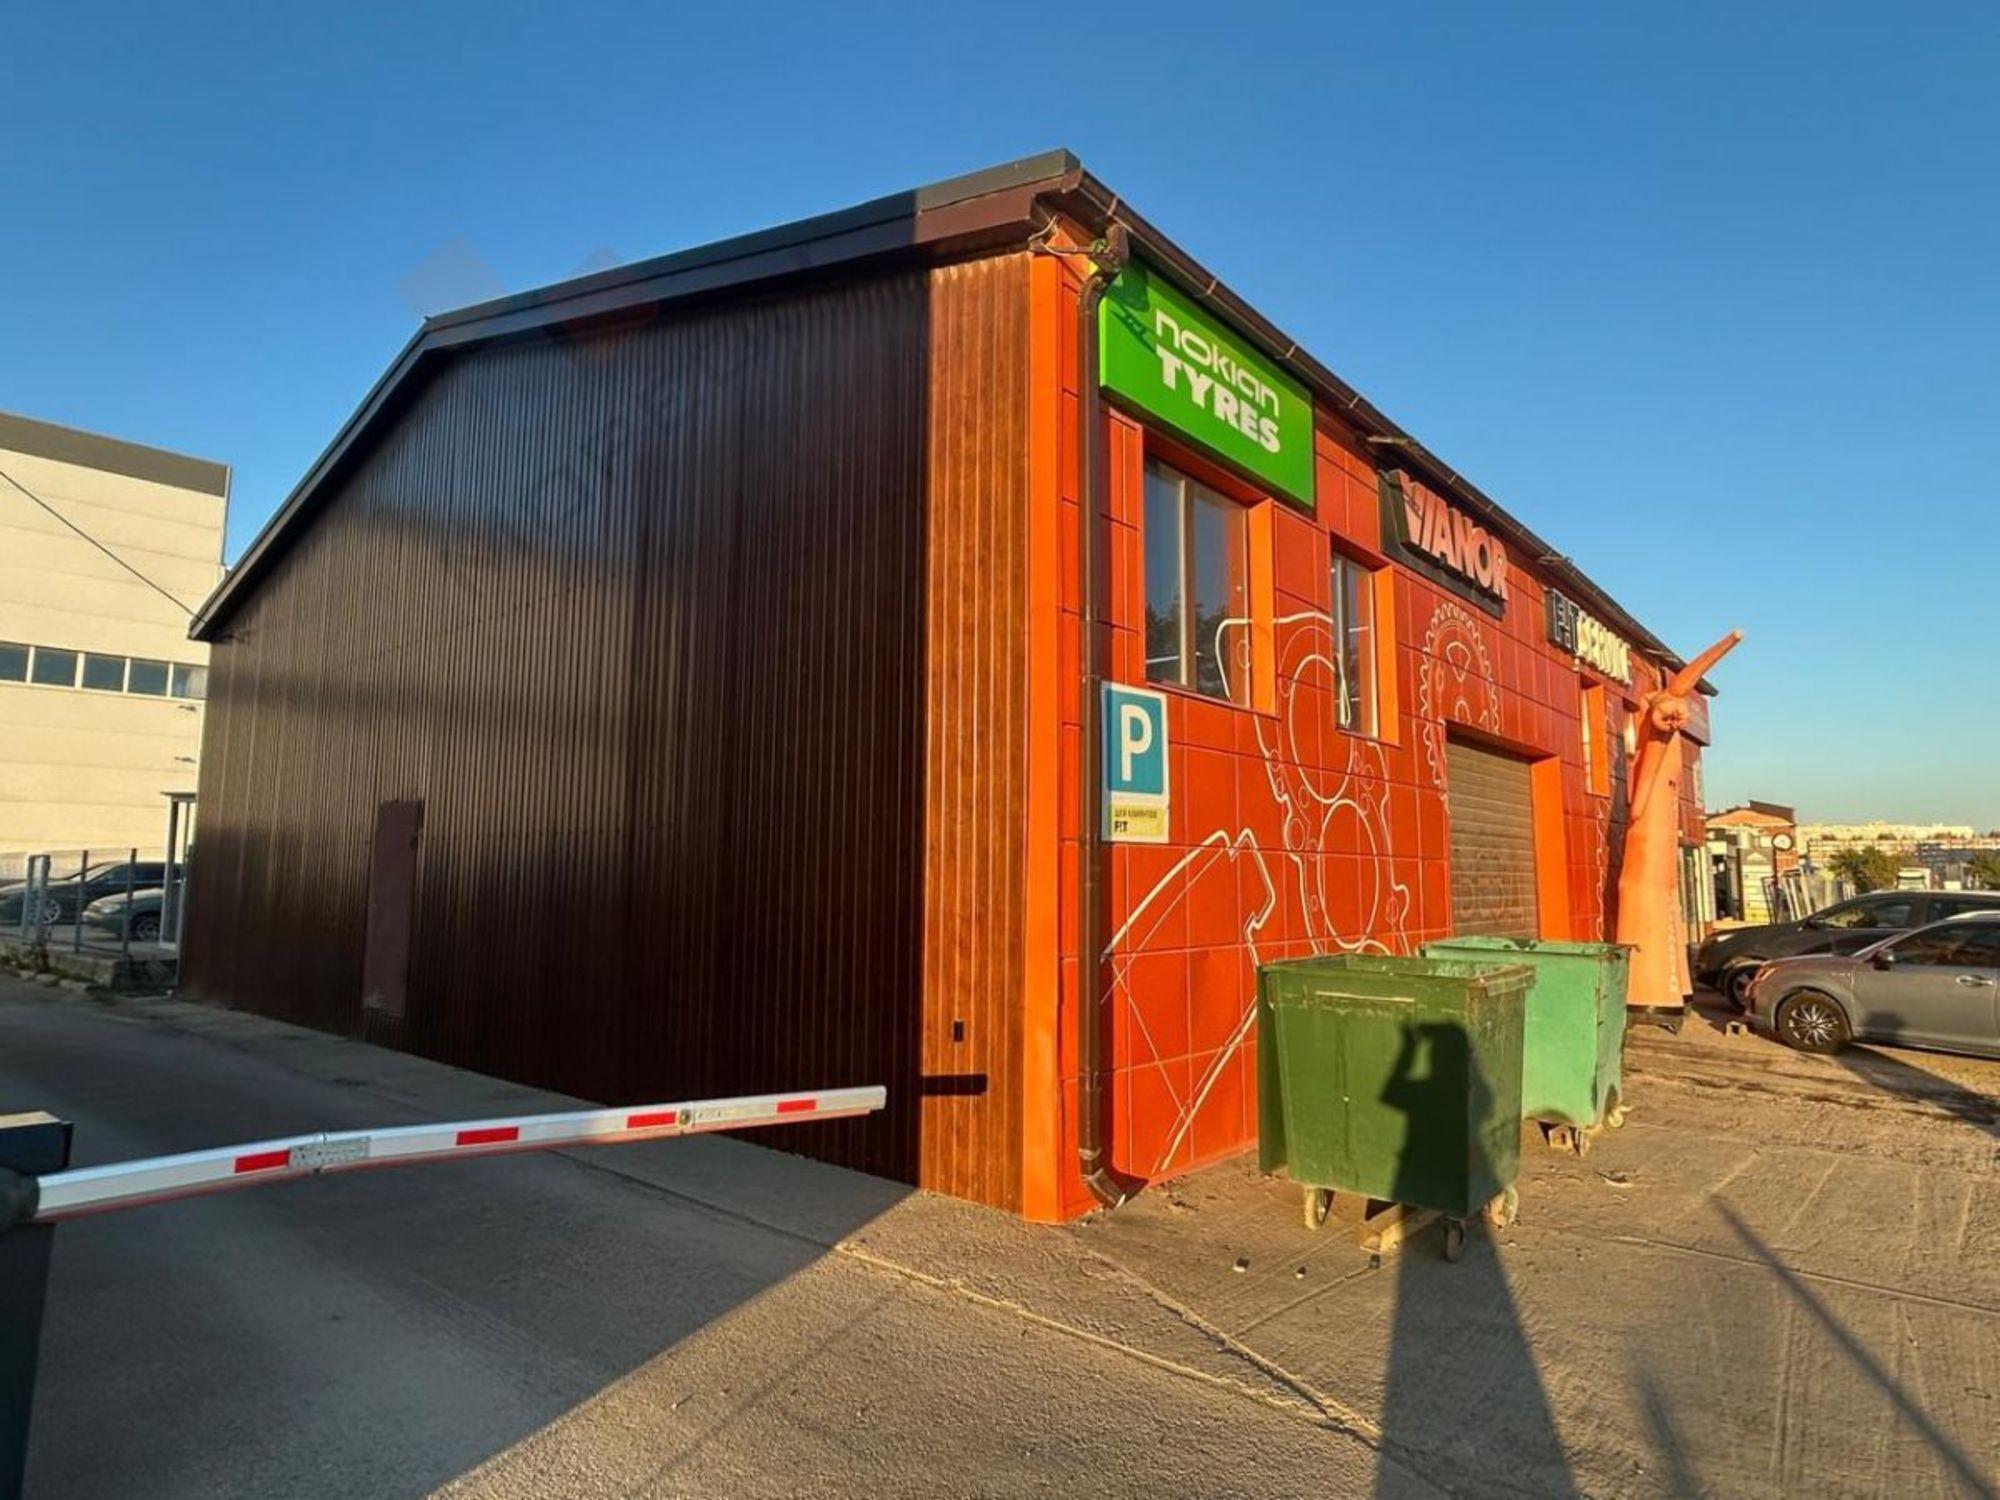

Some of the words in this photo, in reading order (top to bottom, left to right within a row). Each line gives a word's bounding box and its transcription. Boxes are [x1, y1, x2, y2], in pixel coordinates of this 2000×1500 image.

[1155, 344, 1281, 453] TYRES
[1156, 308, 1279, 418] nokian
[1400, 470, 1509, 601] VIANOR
[1120, 704, 1153, 782] P
